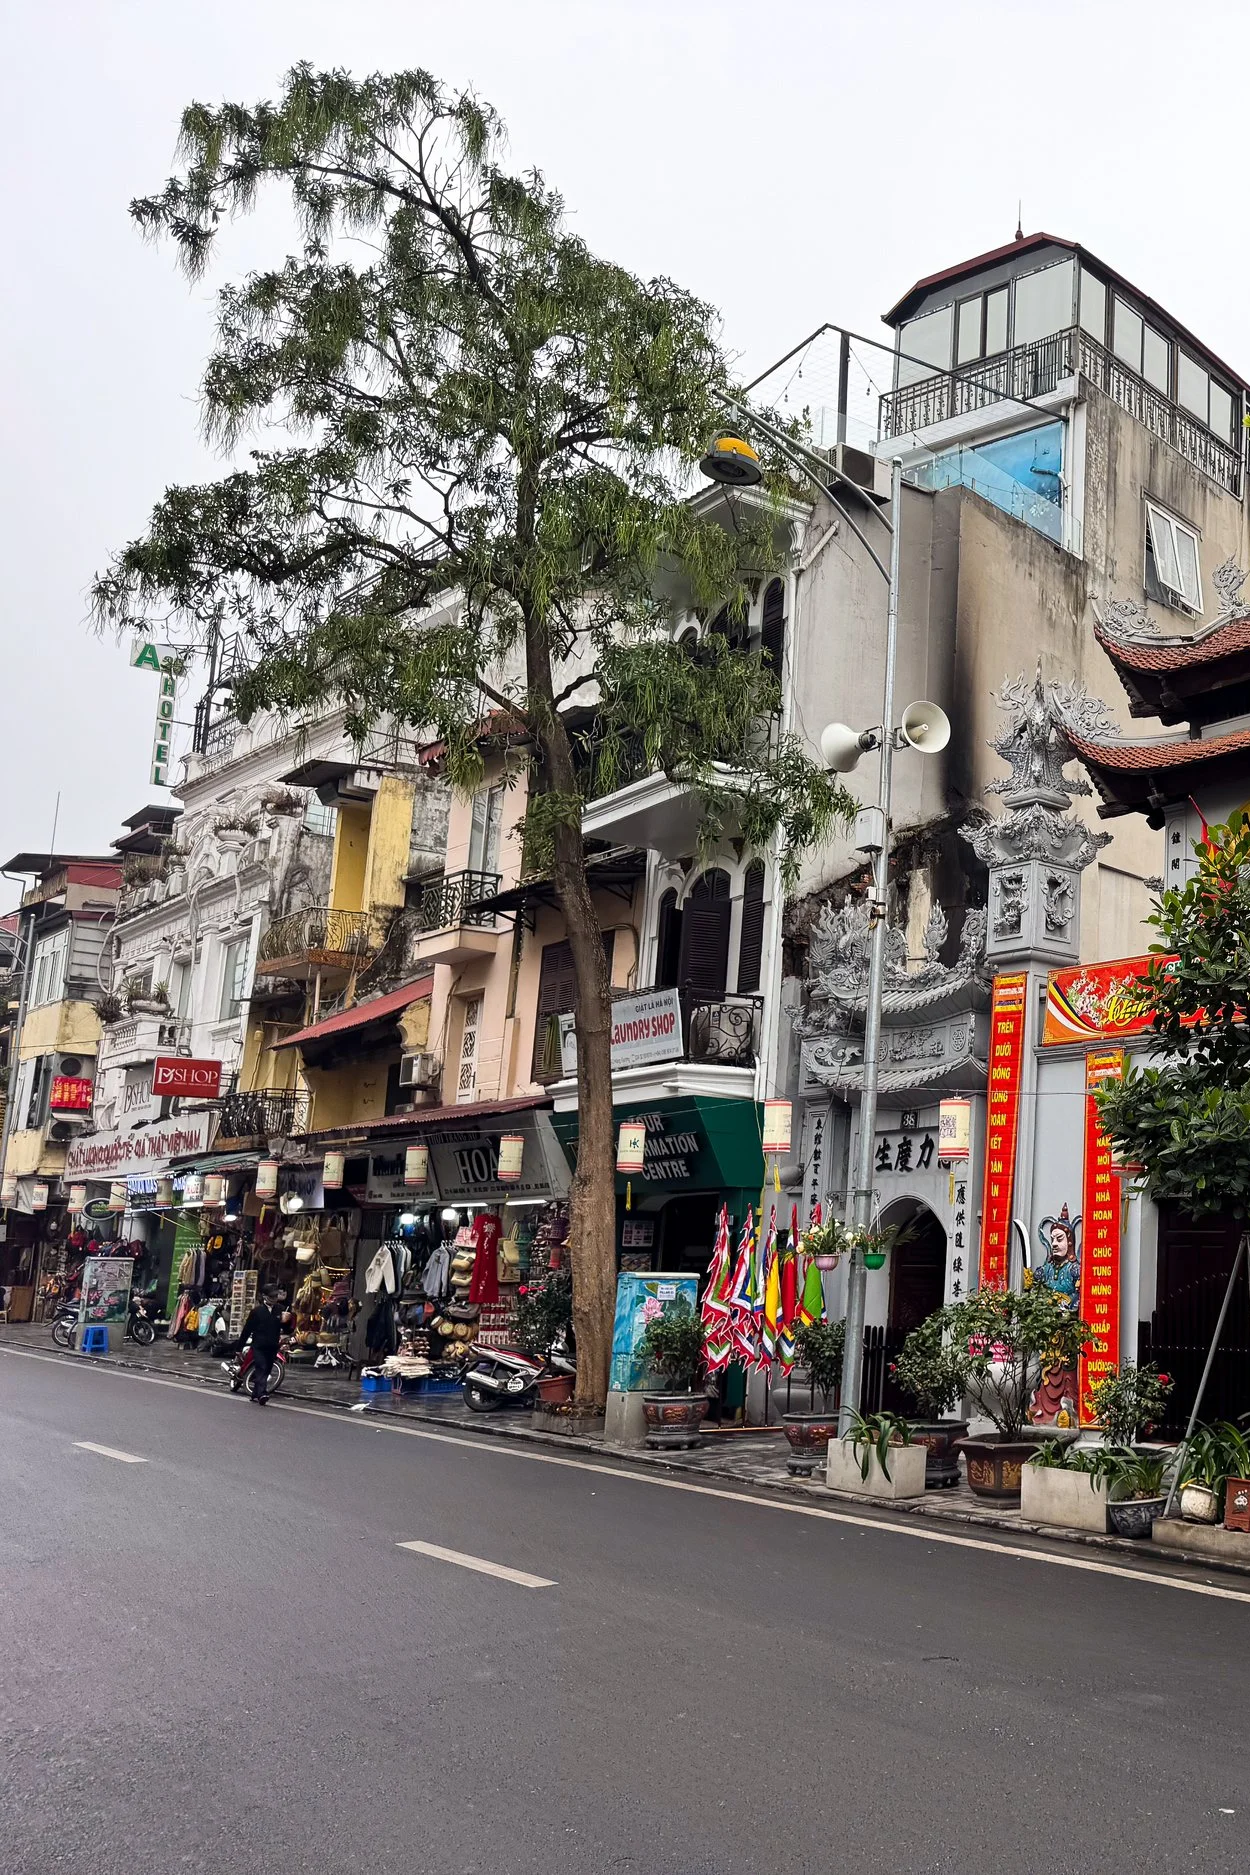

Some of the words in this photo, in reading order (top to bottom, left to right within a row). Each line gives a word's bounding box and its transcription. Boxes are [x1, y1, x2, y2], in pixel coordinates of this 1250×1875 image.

[154, 676, 176, 785] HOTEL
[652, 1012, 676, 1037] SHOP
[997, 1019, 1015, 1034] TRÊN
[995, 1042, 1012, 1057] DƯỚI
[992, 1064, 1011, 1080] ĐỒNG
[902, 1112, 916, 1127] 38
[641, 1160, 690, 1181] CENTRE
[1095, 1171, 1110, 1184] NHÀ
[1095, 1189, 1110, 1202] NHÀ
[1093, 1209, 1112, 1221] HOAN
[1092, 1244, 1112, 1258] CHÚC
[1092, 1266, 1112, 1277] TUNG
[1091, 1282, 1112, 1295] MỪNG
[1095, 1304, 1108, 1314] VUI
[1090, 1318, 1111, 1333] KHẮP
